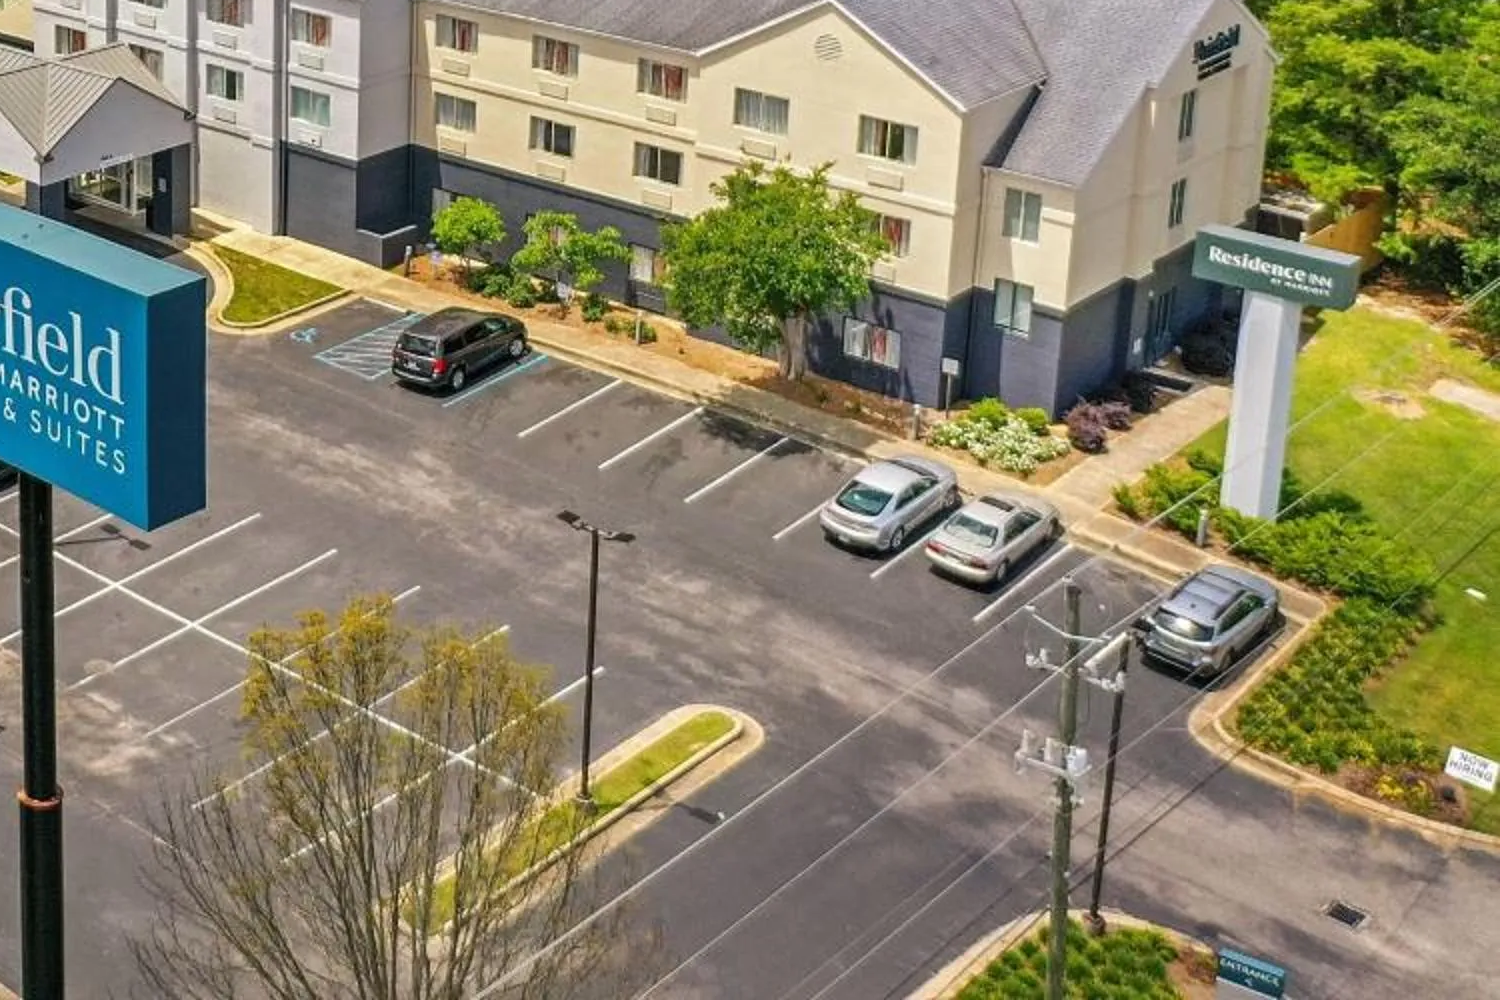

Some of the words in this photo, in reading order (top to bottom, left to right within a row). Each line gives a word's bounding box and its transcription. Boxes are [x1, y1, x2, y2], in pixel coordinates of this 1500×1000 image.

[1209, 245, 1306, 281] Residence
[3, 396, 17, 422] &
[30, 409, 125, 475] SUITES
[1220, 957, 1280, 987] ENTRANCE
